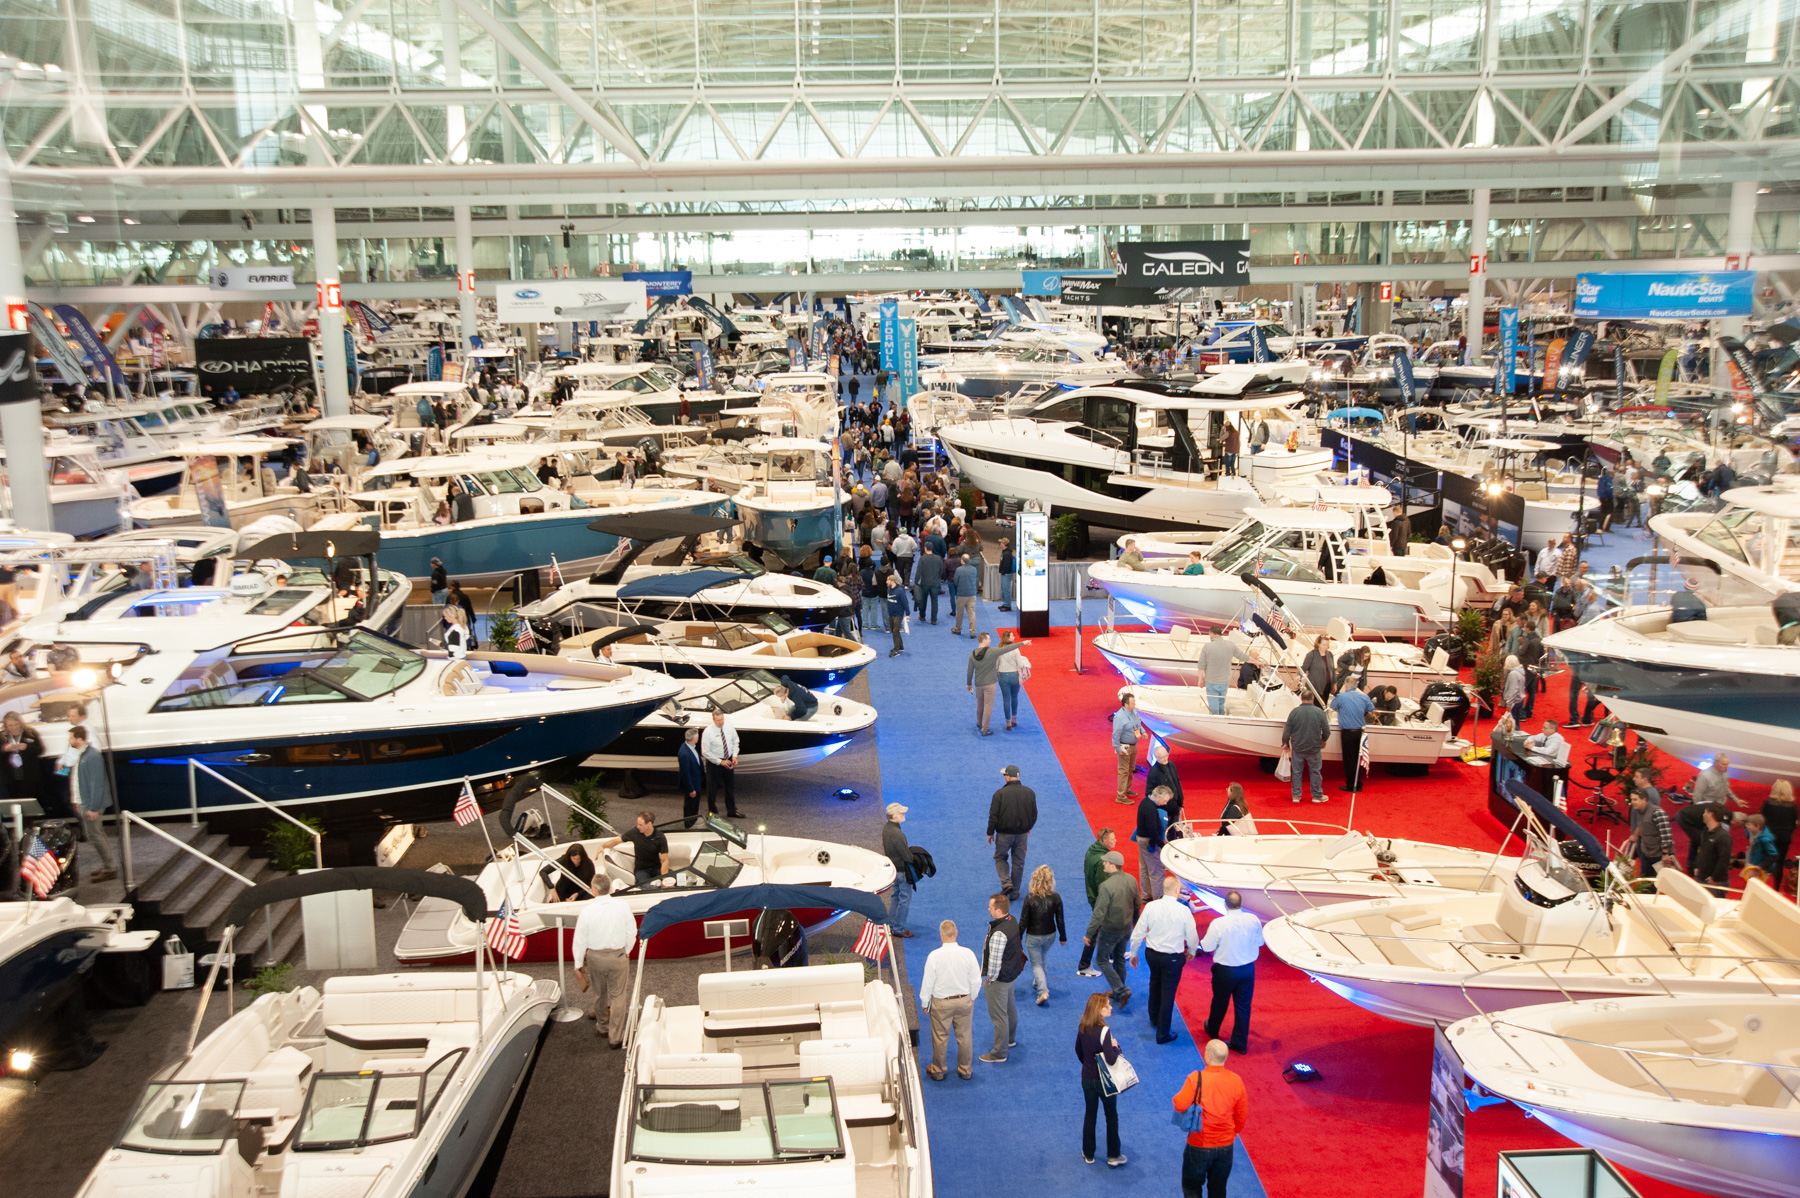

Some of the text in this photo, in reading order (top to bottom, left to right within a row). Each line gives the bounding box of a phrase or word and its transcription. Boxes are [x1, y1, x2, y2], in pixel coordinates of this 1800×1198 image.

[1143, 261, 1224, 276] GALEON
[248, 275, 289, 283] EVINRUDE
[1648, 281, 1731, 297] NauticStar
[1697, 295, 1725, 304] BOATS
[1650, 308, 1729, 317] NauticStarBoats.com
[884, 320, 894, 369] FORMULA
[1557, 331, 1589, 390] BALINER
[903, 341, 913, 398] FORMUL
[233, 583, 259, 591] SIMRAD
